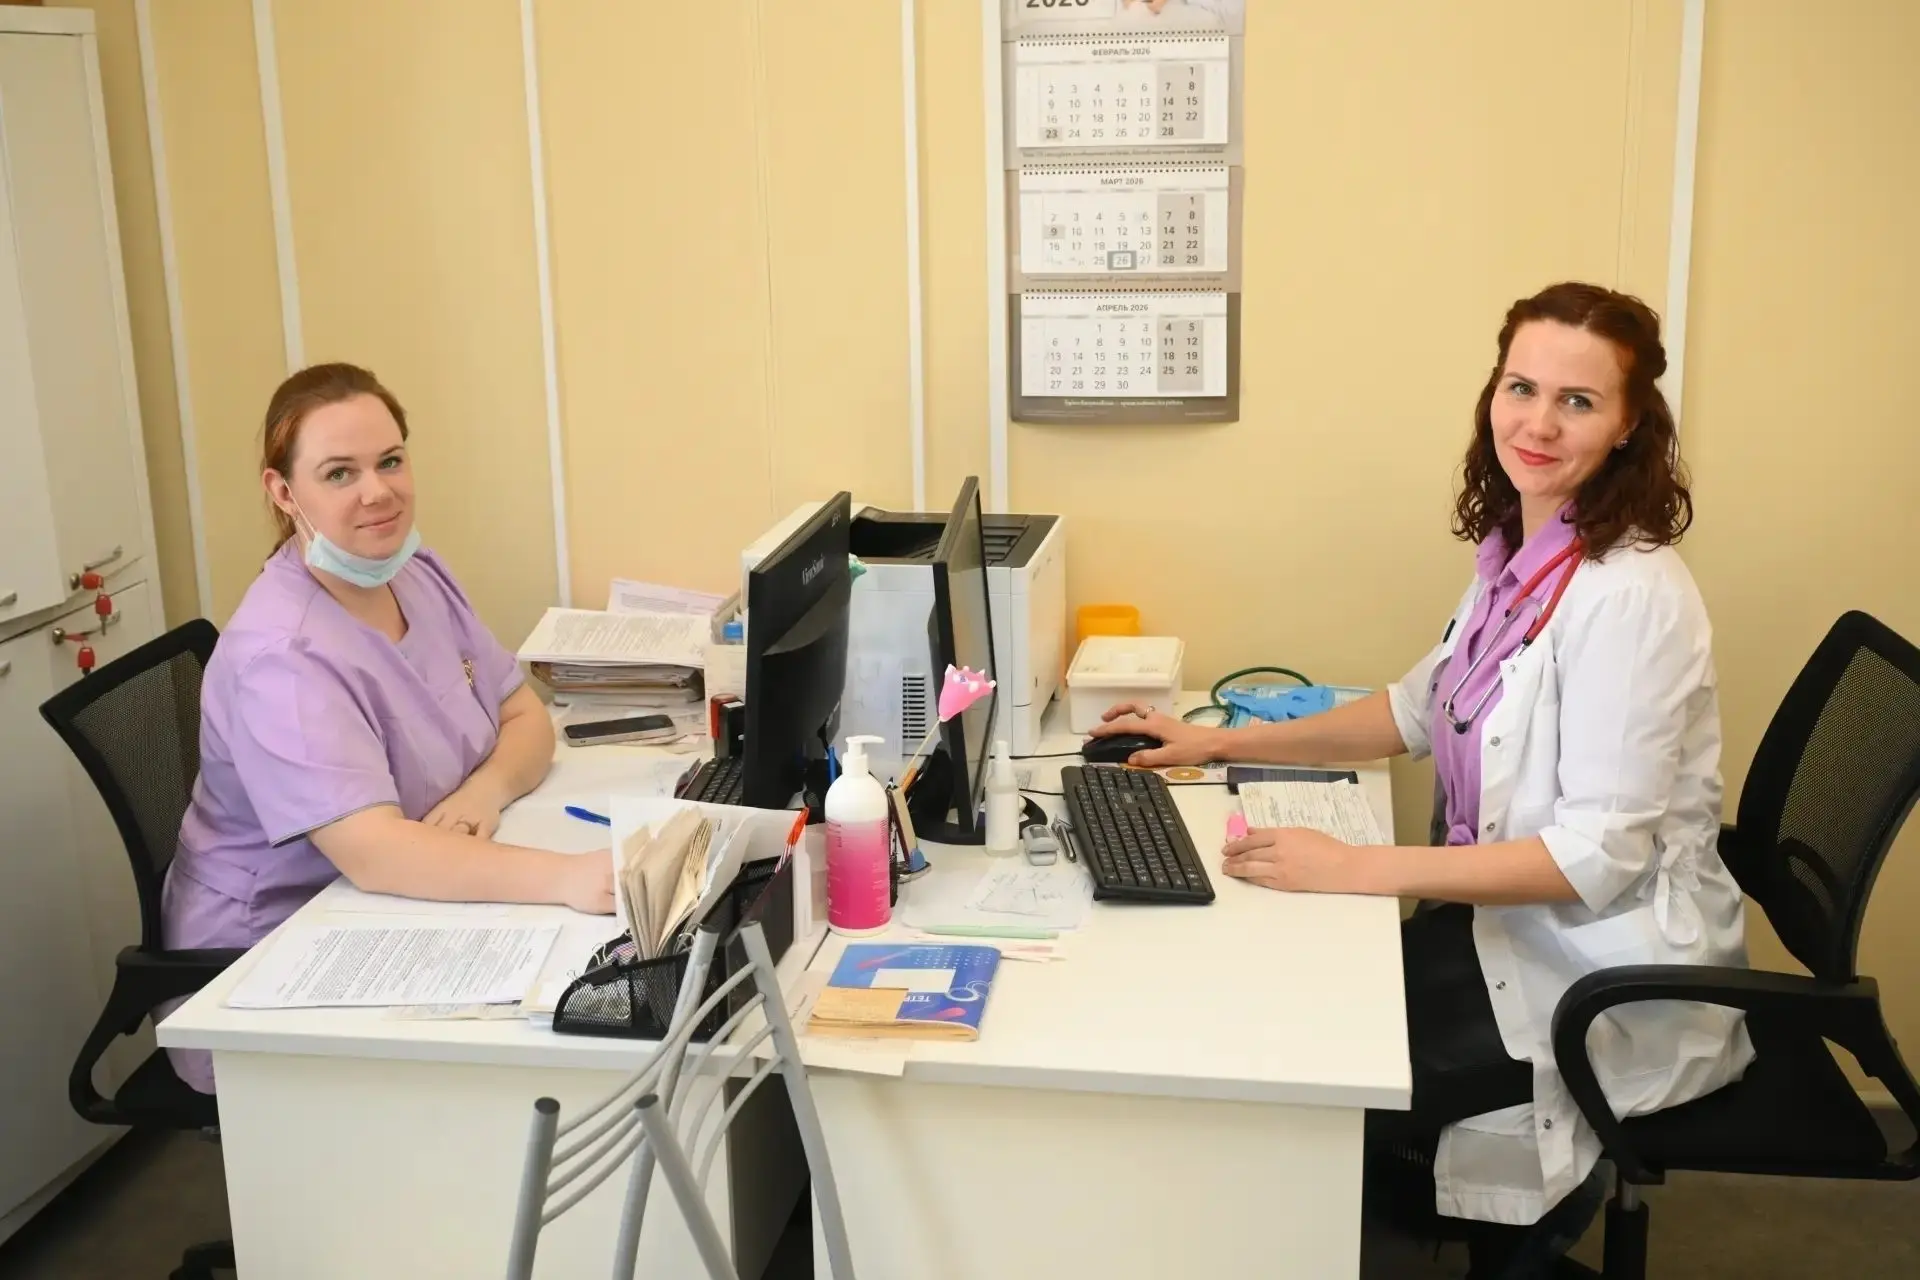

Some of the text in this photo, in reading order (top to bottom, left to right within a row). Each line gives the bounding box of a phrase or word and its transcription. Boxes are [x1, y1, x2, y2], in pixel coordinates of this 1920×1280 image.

[1190, 66, 1194, 75] 1
[1048, 81, 1195, 94] 2 3 4 5 6 7 8
[1048, 96, 1198, 110] 9 10 11 12 13 14 15
[1046, 111, 1198, 124] 16 17 18 19 20 21 22
[1046, 127, 1174, 139] 23 24 25 26 27 28
[1190, 196, 1194, 204] 1
[1051, 211, 1195, 222] 2 3 4 5 6 7 8
[1050, 227, 1058, 236] 9
[1072, 227, 1082, 236] 10
[1094, 227, 1104, 235] 11
[1117, 227, 1128, 236] 12
[1140, 226, 1152, 236] 13
[1187, 226, 1198, 234] 15
[1049, 240, 1198, 251] 16 17 18 19 20 21 22
[1094, 256, 1105, 265] 25
[1116, 255, 1128, 264] 26
[1140, 255, 1151, 265] 27
[1162, 255, 1175, 264] 28
[1186, 255, 1198, 264] 29
[1097, 322, 1195, 332] 1 2 3 4 5
[1052, 337, 1198, 347] 6 7 8 9 10 11 12
[1050, 351, 1198, 361] 13 14 15 16 17 18 19
[1050, 366, 1198, 376] 20 21 22 23 24 25 26
[1050, 380, 1129, 390] 27 28 29 30
